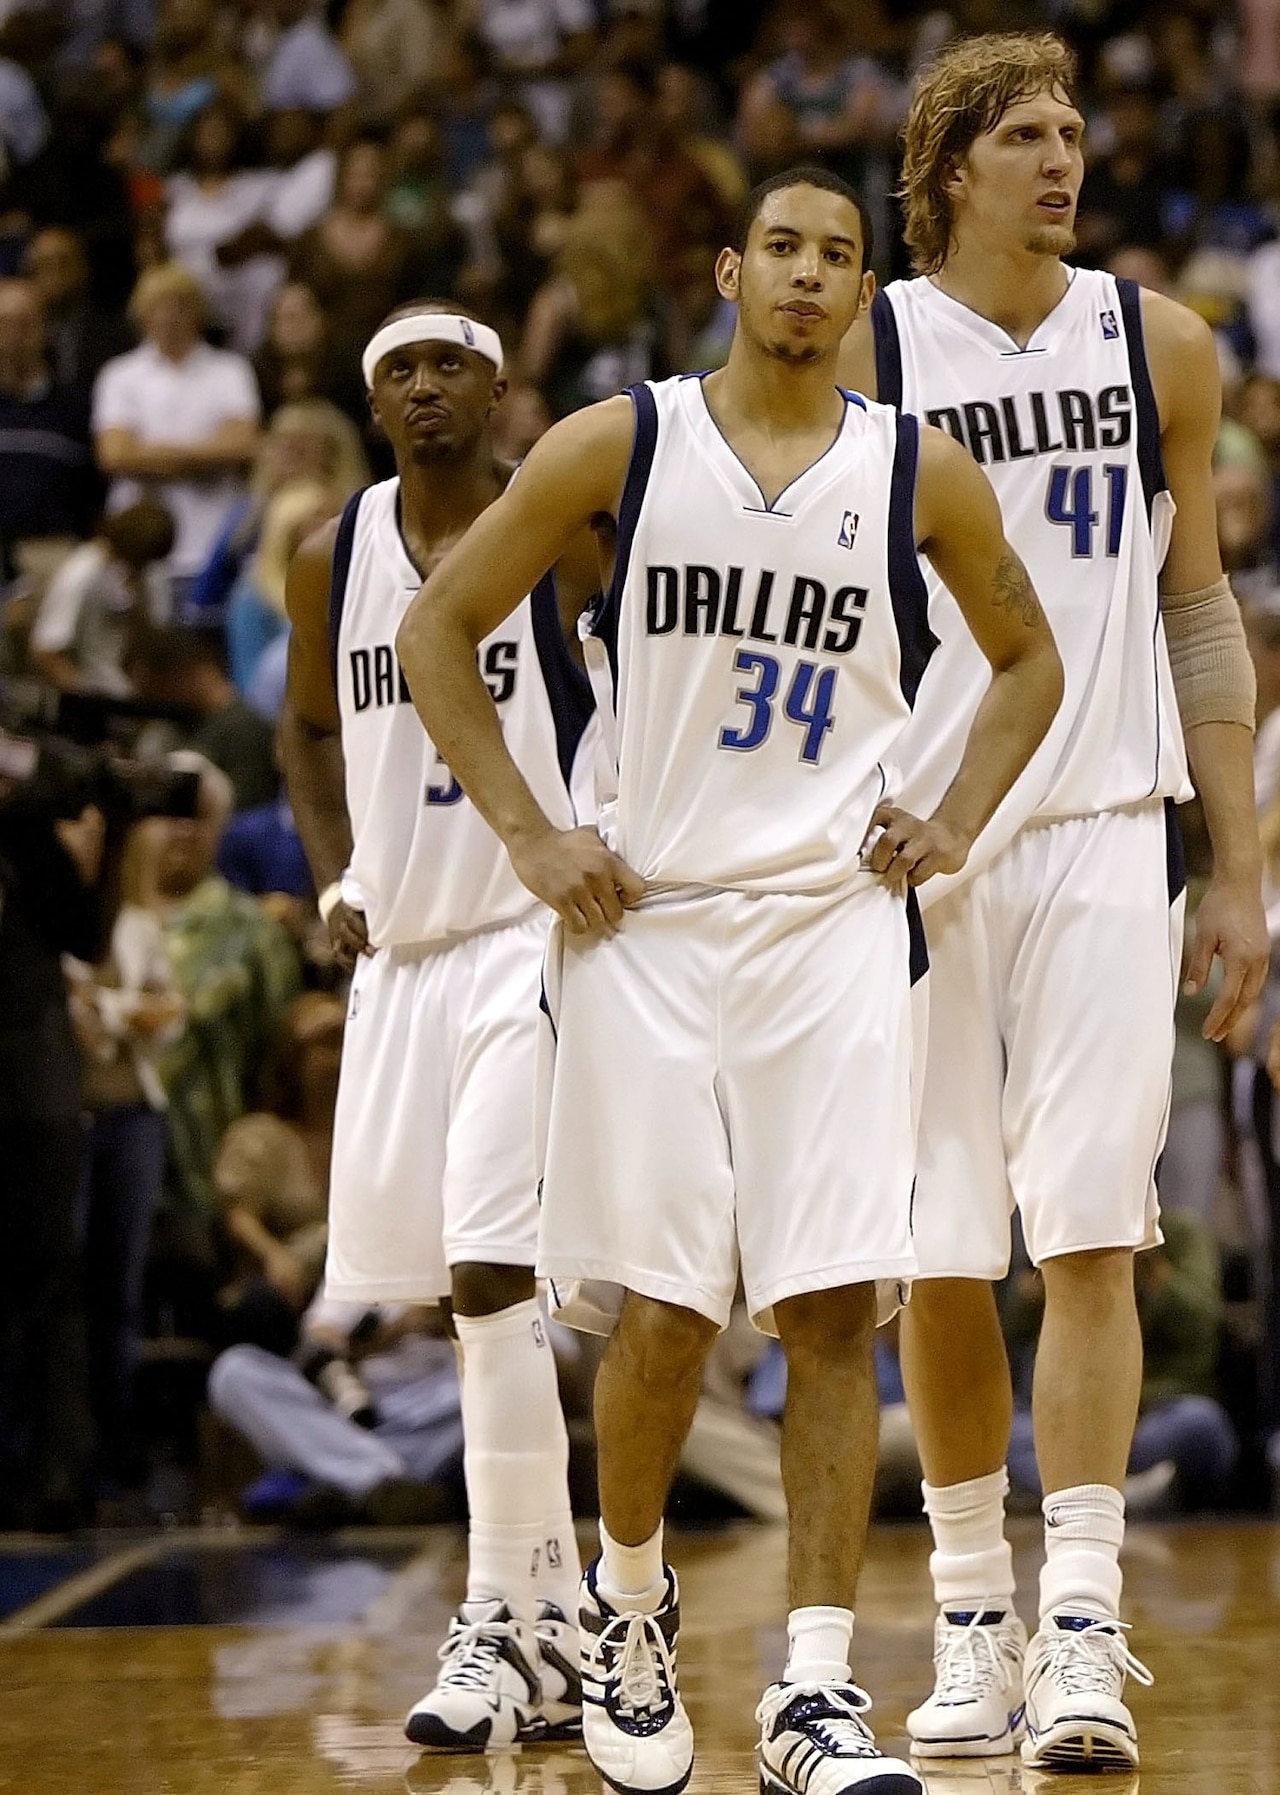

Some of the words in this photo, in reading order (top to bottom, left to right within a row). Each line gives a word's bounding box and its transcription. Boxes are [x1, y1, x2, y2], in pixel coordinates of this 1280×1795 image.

[925, 385, 1132, 465] DALLAS
[1045, 463, 1129, 559] 41
[645, 563, 870, 656] DALLAS
[350, 641, 519, 713] DAS
[717, 648, 840, 766] 34
